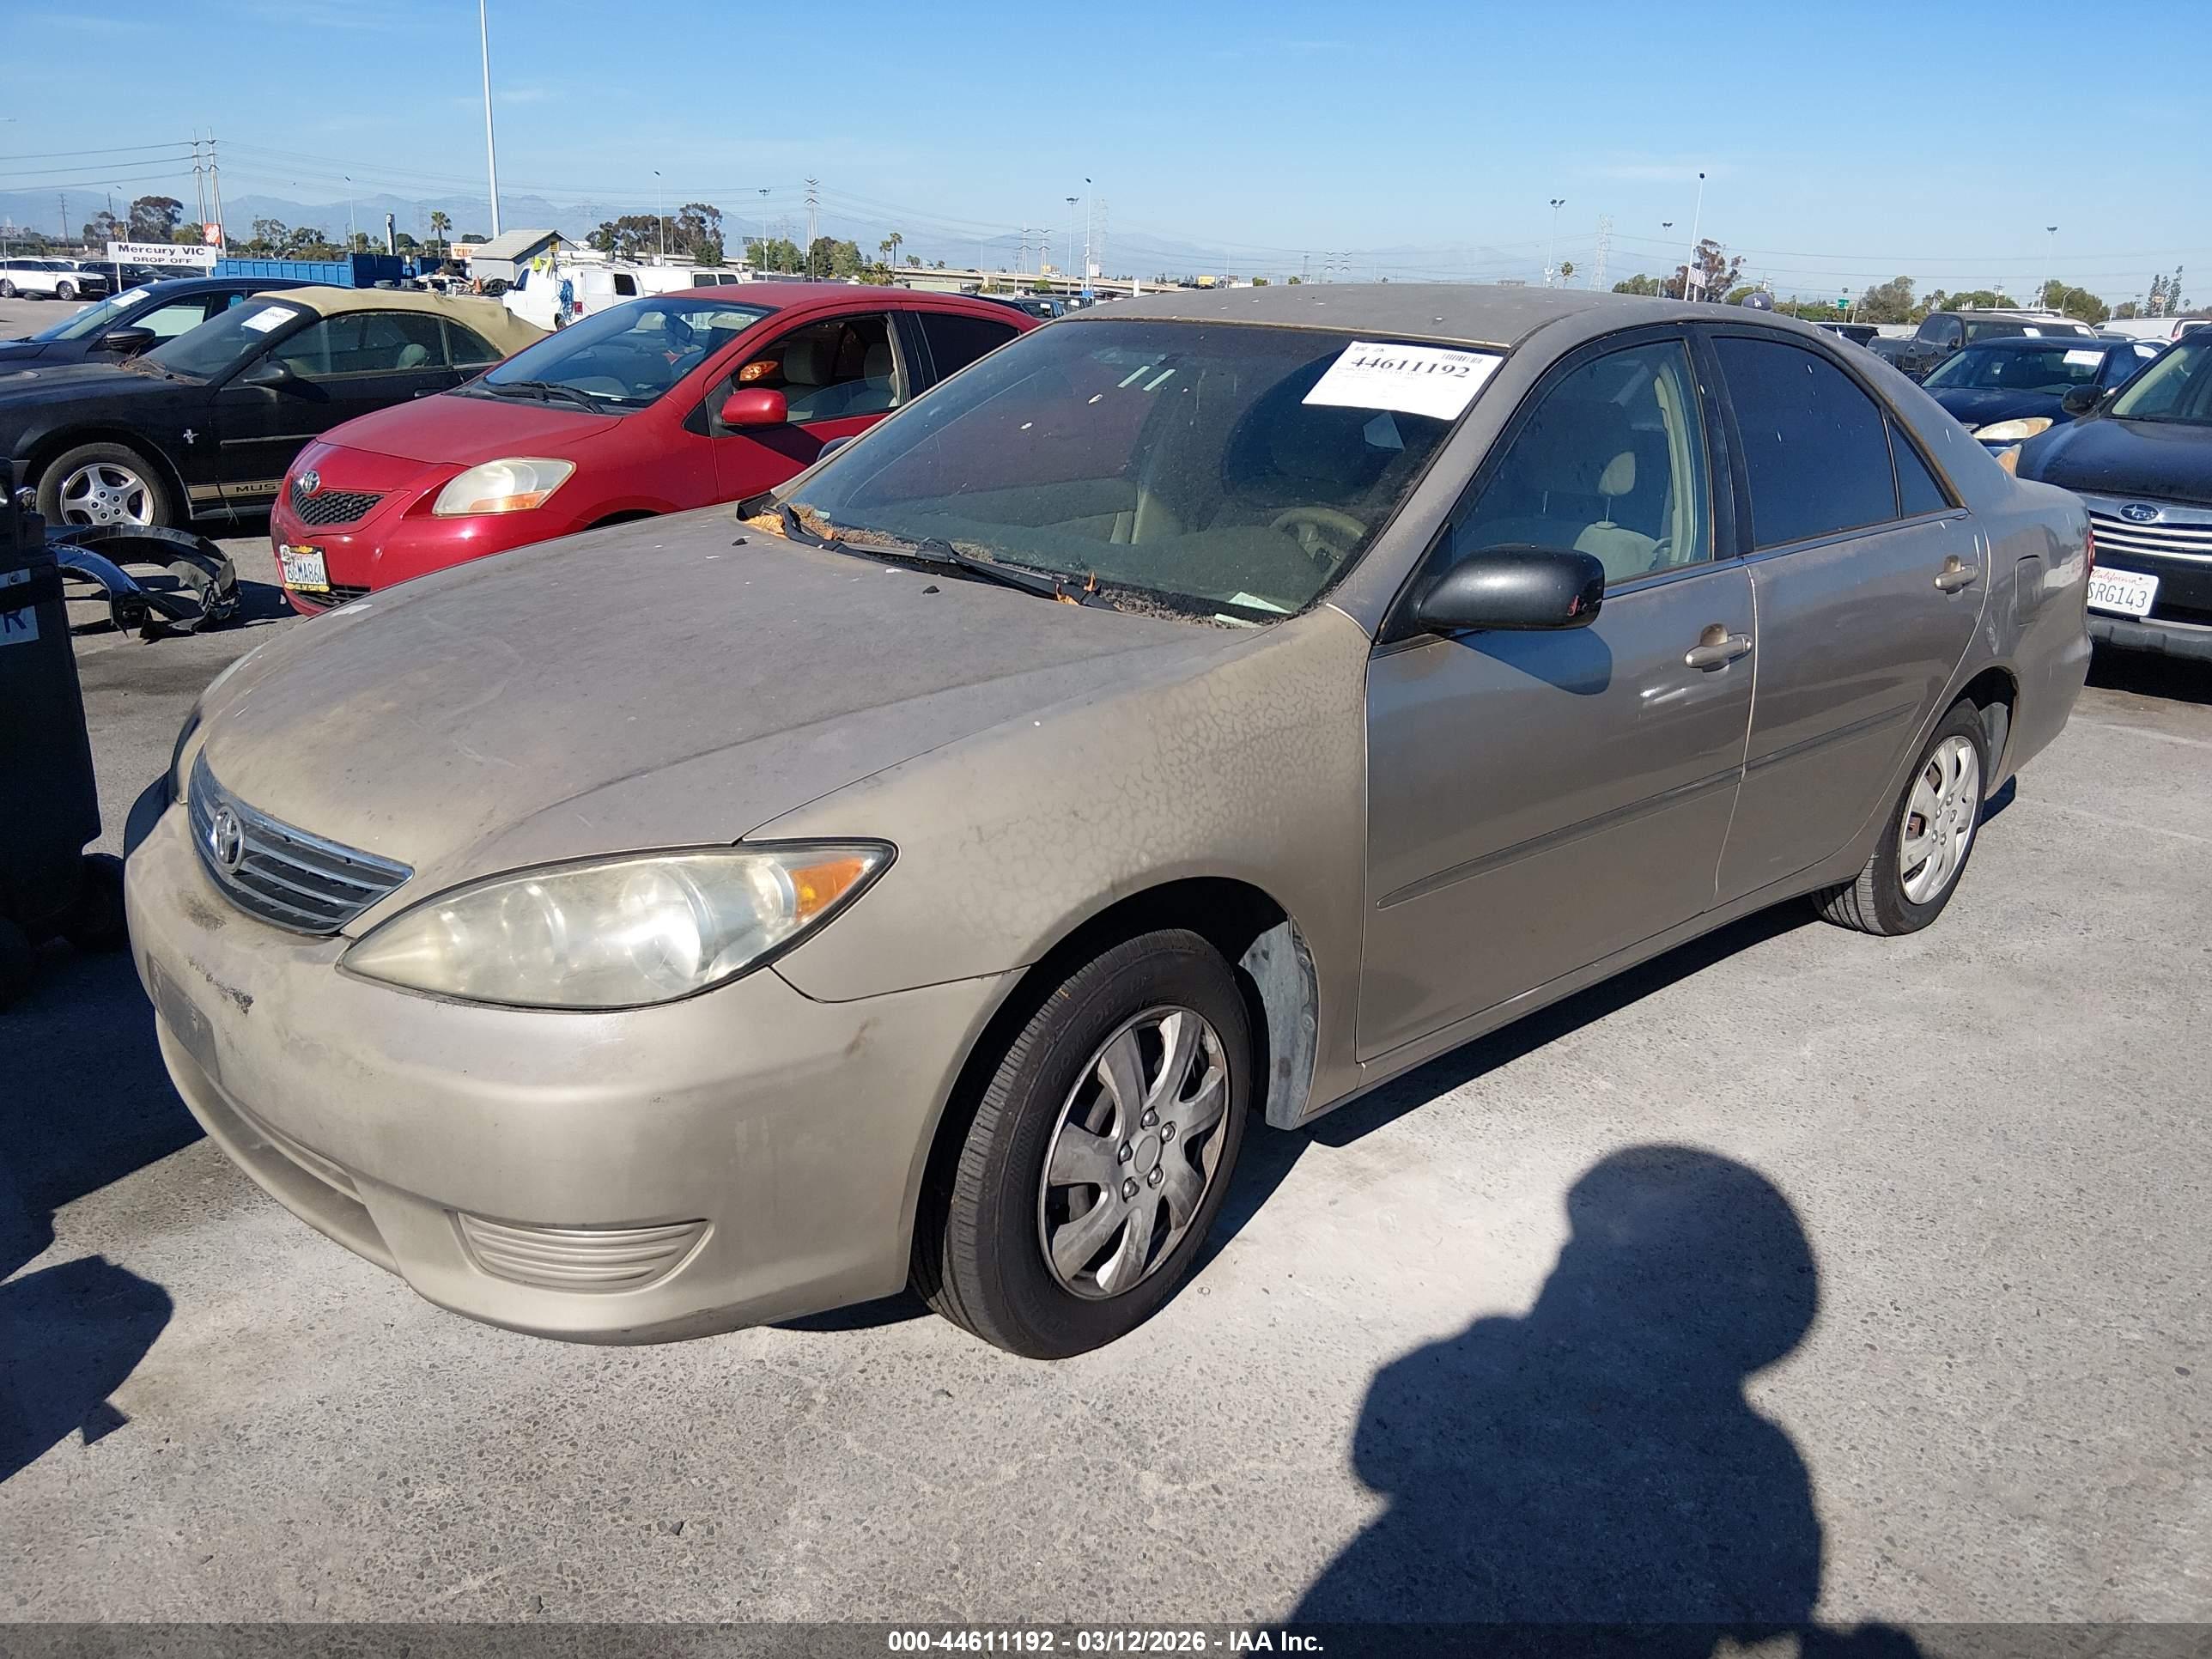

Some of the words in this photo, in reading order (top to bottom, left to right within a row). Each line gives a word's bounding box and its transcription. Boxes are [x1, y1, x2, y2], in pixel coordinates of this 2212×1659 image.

[118, 244, 175, 256] Mercury
[182, 246, 205, 256] VIC
[1351, 356, 1470, 378] 44611192
[2087, 581, 2148, 608] SRG143
